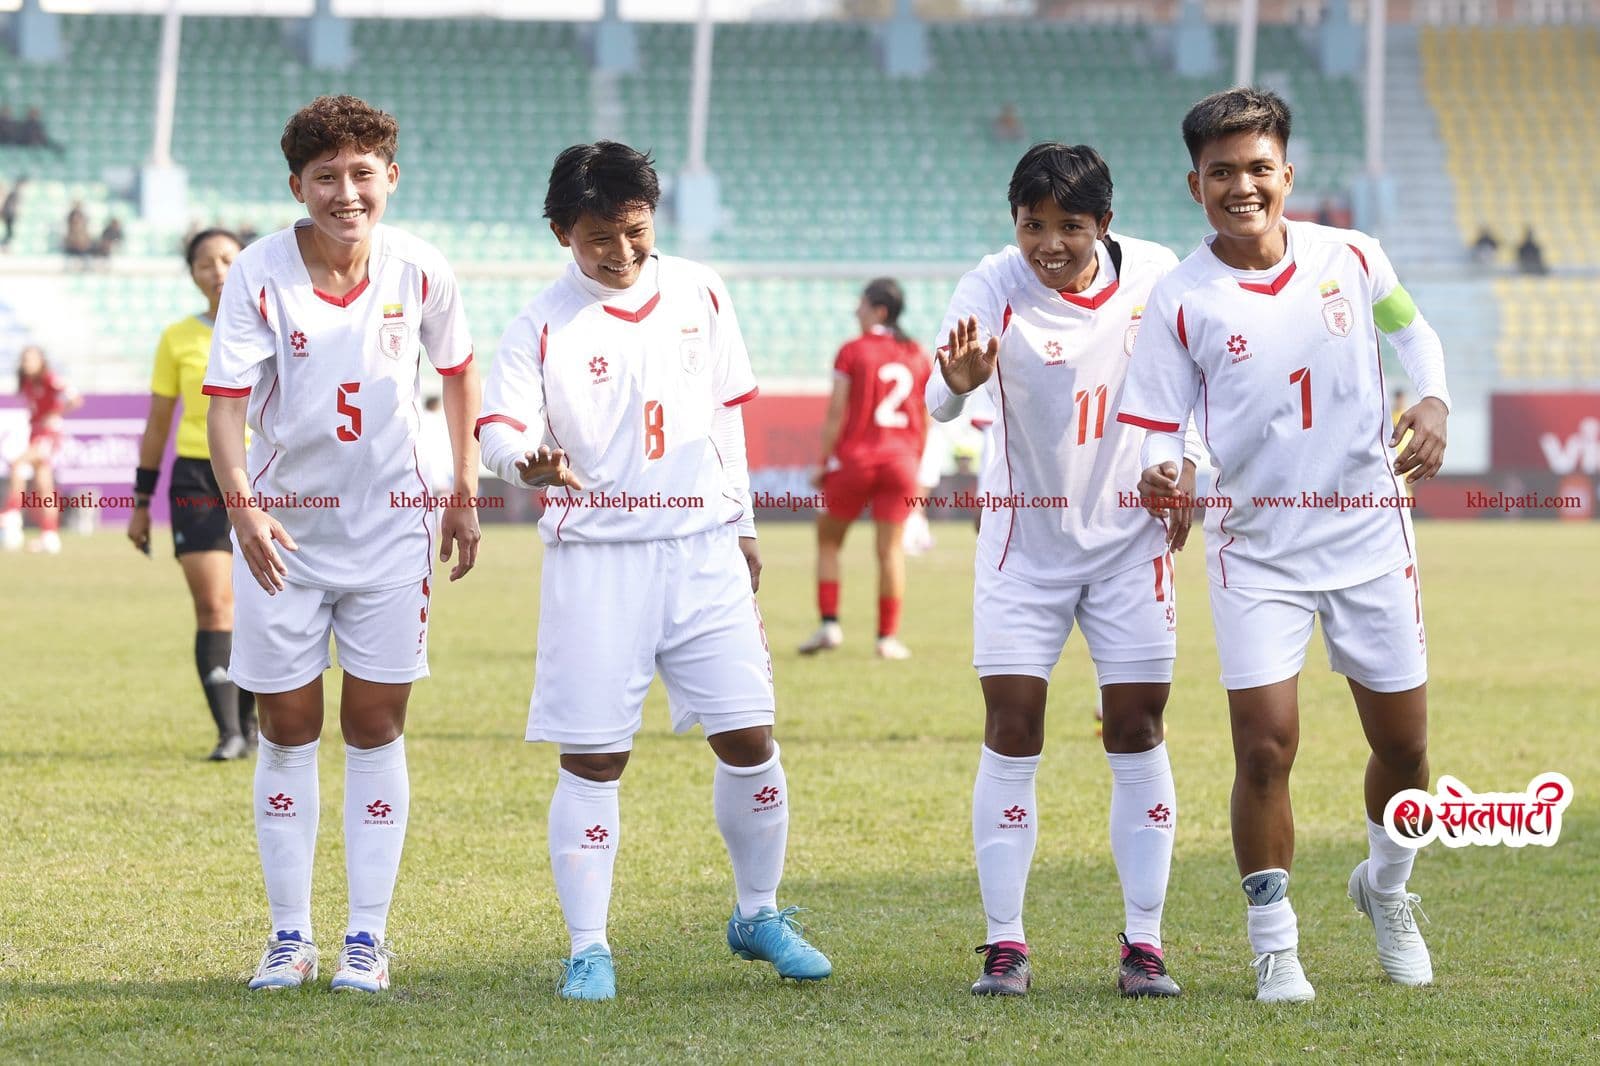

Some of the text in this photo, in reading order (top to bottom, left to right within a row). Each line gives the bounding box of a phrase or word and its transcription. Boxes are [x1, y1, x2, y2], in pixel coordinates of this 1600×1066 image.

[336, 382, 362, 442] 5
[874, 362, 914, 428] 2
[1075, 383, 1108, 446] 11
[1289, 366, 1313, 430] 1
[644, 400, 665, 460] 8
